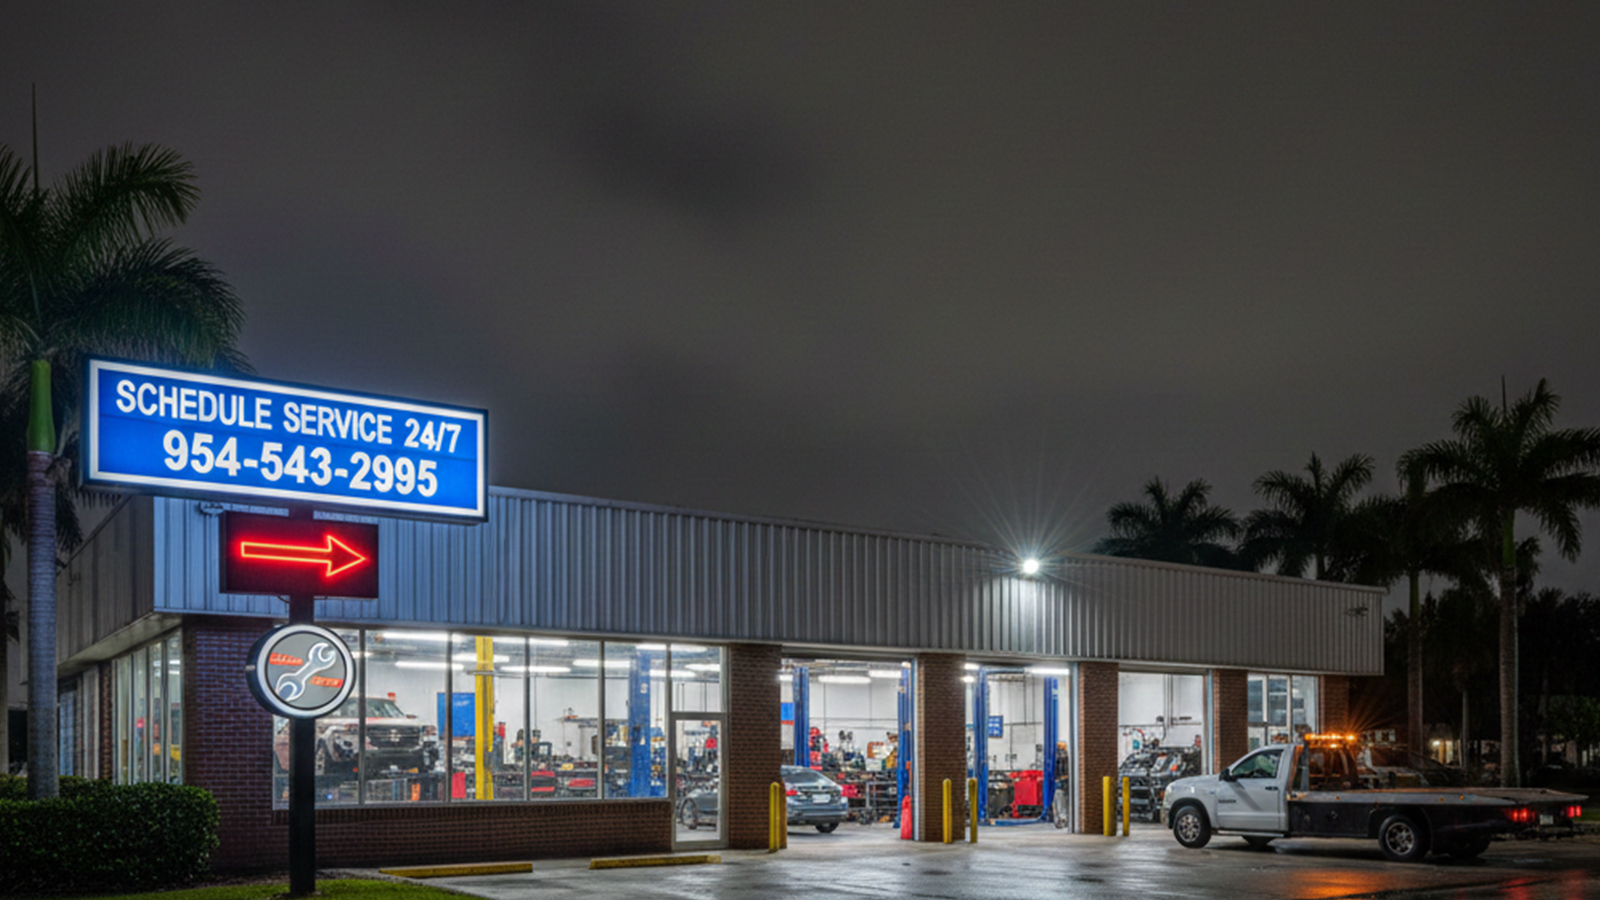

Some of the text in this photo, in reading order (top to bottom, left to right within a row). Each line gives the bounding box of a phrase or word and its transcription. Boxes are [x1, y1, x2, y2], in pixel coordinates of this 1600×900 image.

[116, 379, 462, 453] SCHEDULE SERVICE 24/7
[163, 430, 438, 498] 954-543-2995
